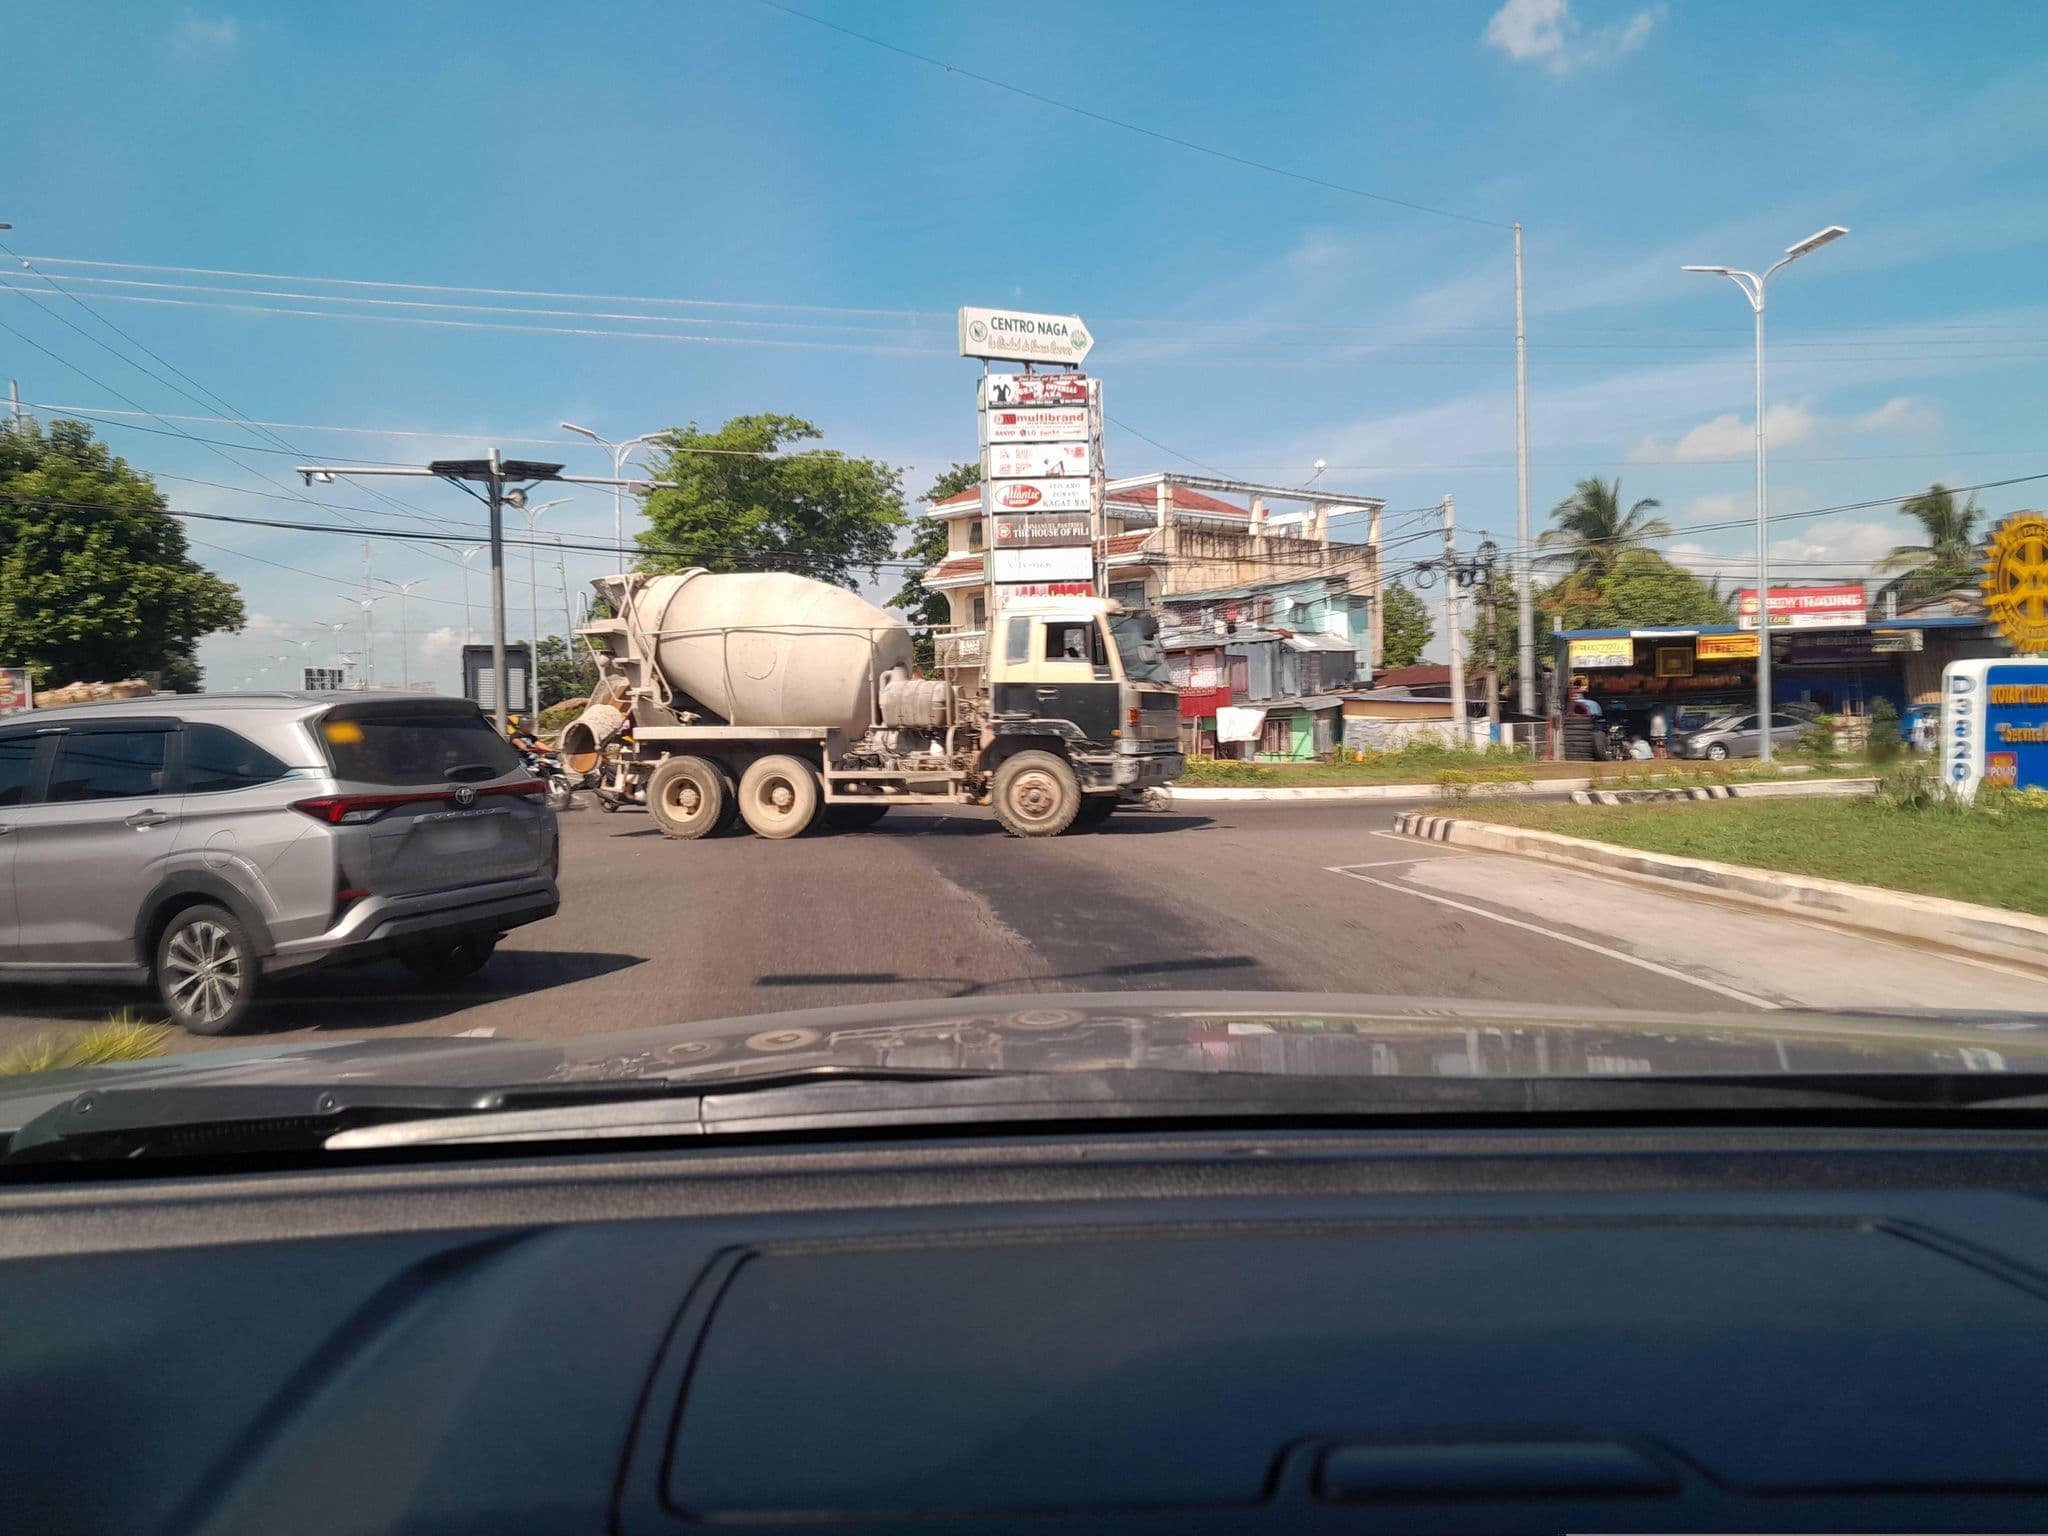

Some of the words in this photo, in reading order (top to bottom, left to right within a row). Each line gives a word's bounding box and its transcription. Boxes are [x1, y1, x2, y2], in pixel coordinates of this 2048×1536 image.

[990, 316, 1035, 334] CENTRO
[1037, 320, 1069, 337] NAGA
[1017, 412, 1084, 423] multibrand
[1012, 528, 1030, 539] THE
[1031, 528, 1059, 538] HOUSE
[1060, 527, 1071, 537] OF
[1072, 527, 1089, 536] PILI
